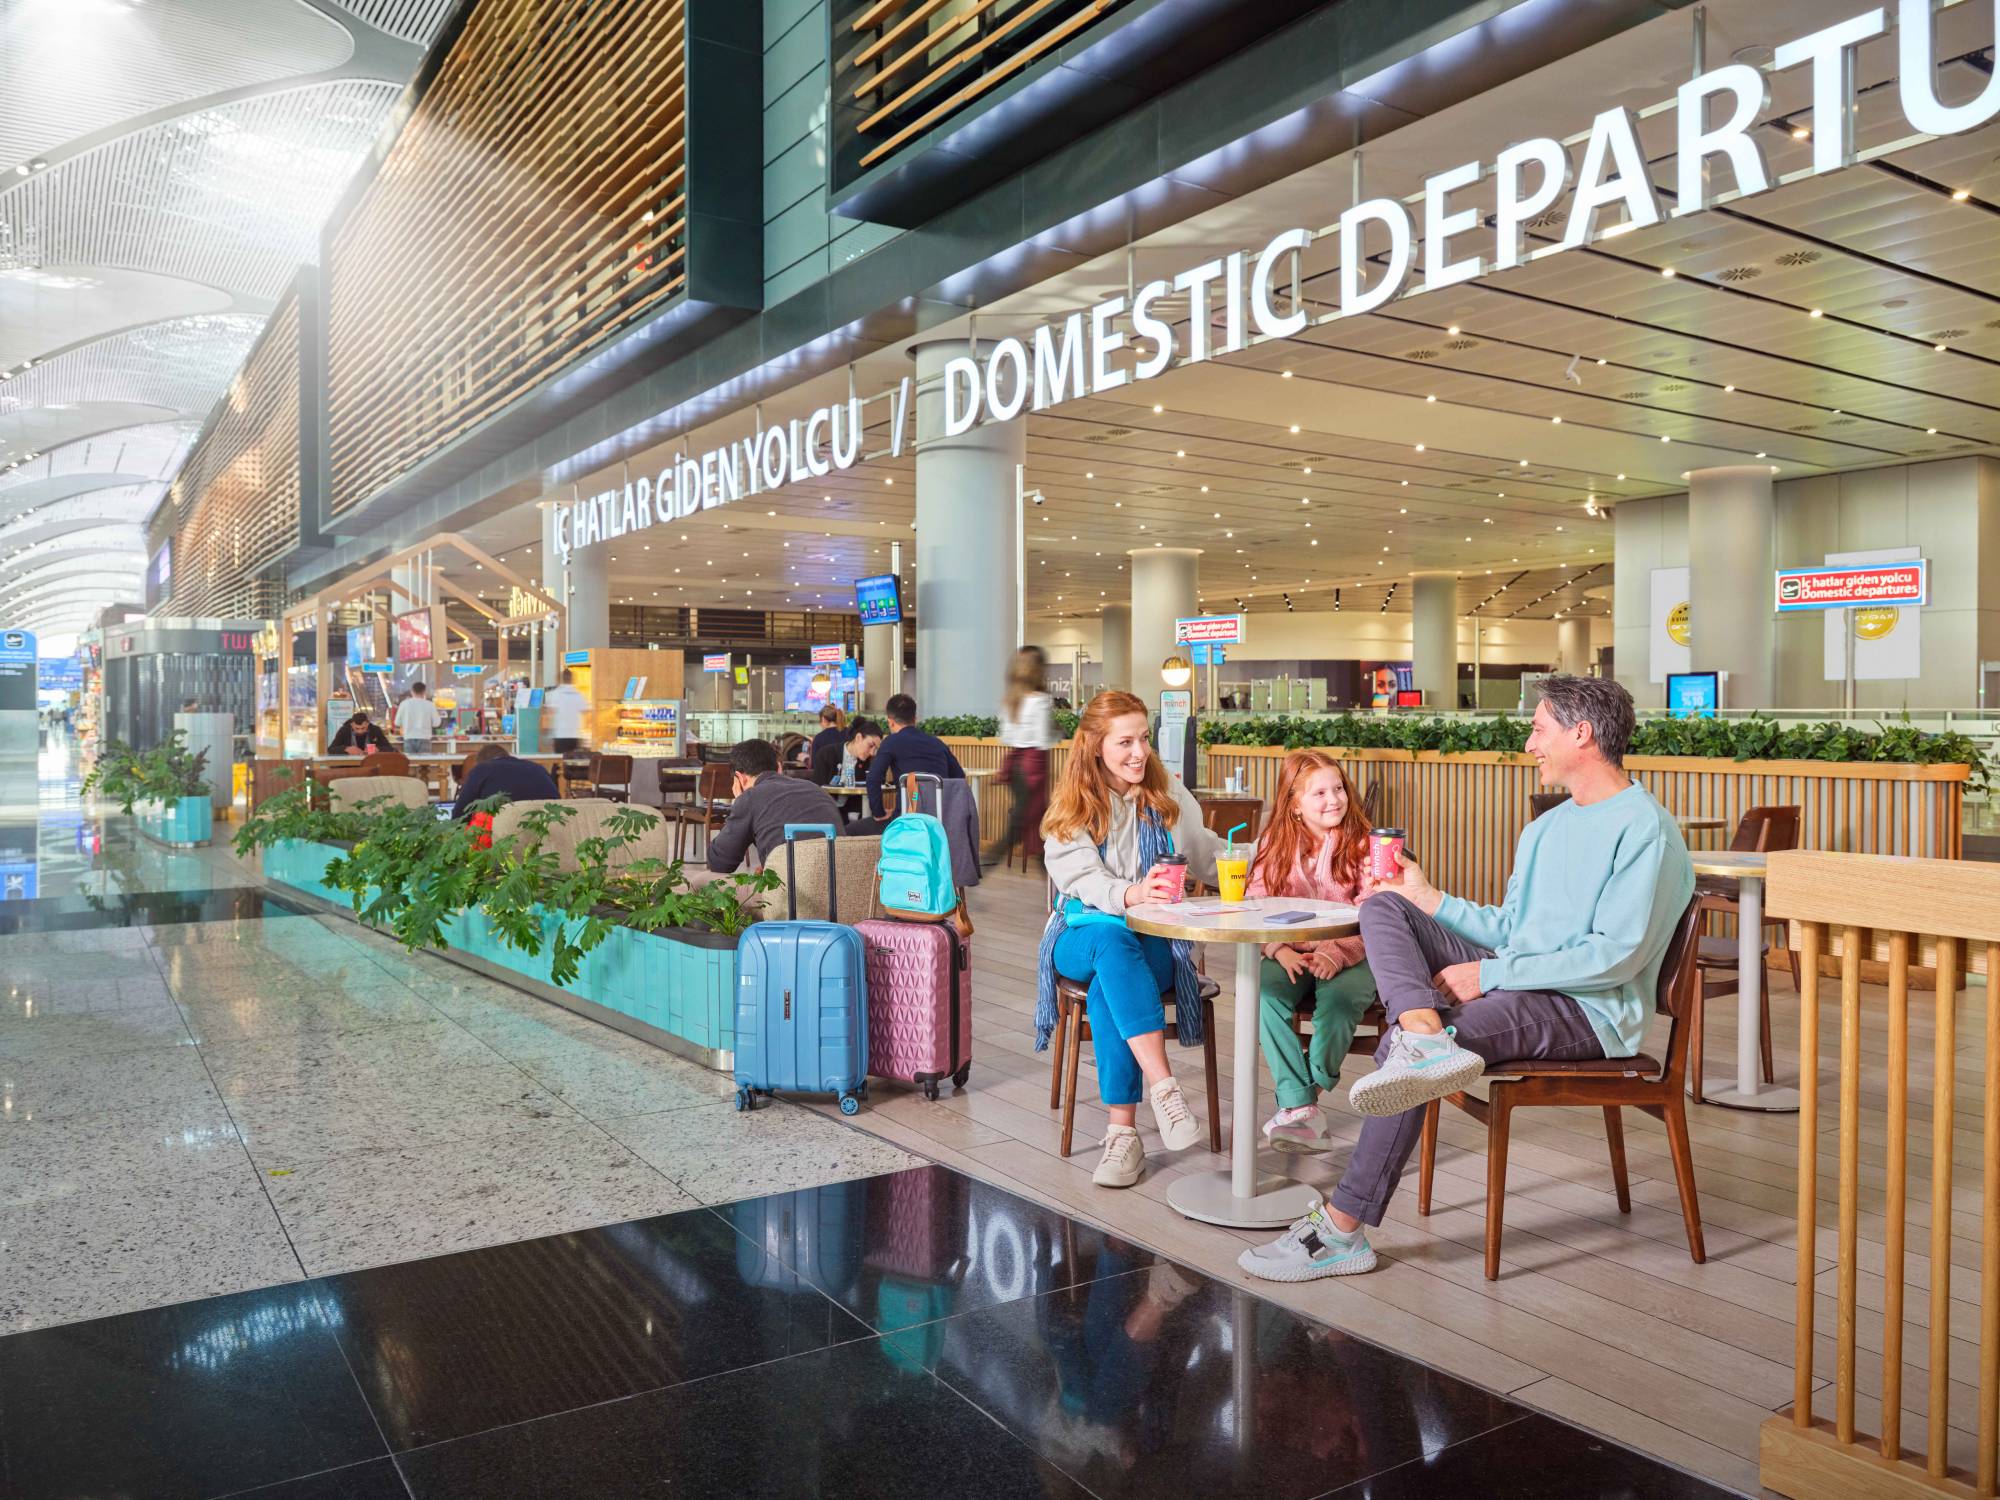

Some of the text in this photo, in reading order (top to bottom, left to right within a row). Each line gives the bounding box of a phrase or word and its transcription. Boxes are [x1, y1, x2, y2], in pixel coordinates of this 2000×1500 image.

[553, 502, 571, 566] İÇ
[573, 477, 653, 549] HATLAR
[656, 452, 742, 522] GİDEN
[744, 397, 861, 495] YOLCU
[945, 228, 1314, 437] DOMESTIC
[1813, 575, 1844, 588] hatlar
[1846, 574, 1879, 589] giden
[1881, 572, 1912, 587] yolcu
[1802, 584, 1918, 600] Domestic departures
